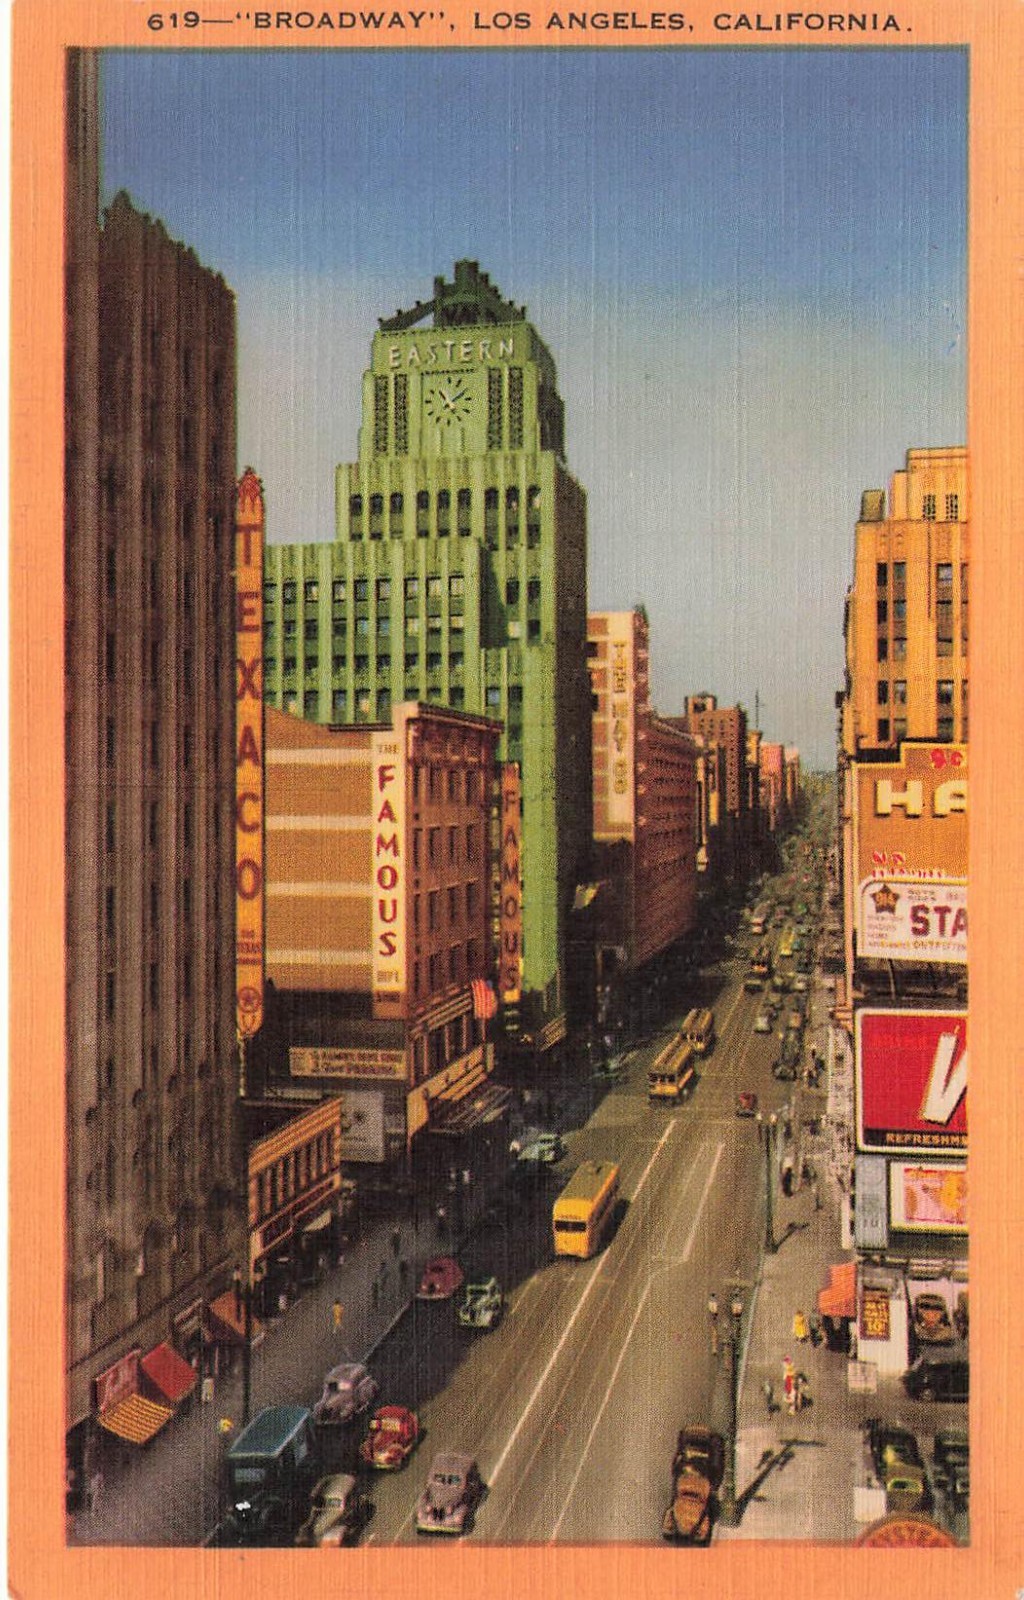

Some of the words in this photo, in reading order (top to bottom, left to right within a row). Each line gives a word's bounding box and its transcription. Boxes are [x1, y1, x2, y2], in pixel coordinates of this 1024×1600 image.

[388, 338, 514, 368] EASTERN
[236, 523, 263, 900] TEXACO
[376, 764, 399, 957] FAMOUS
